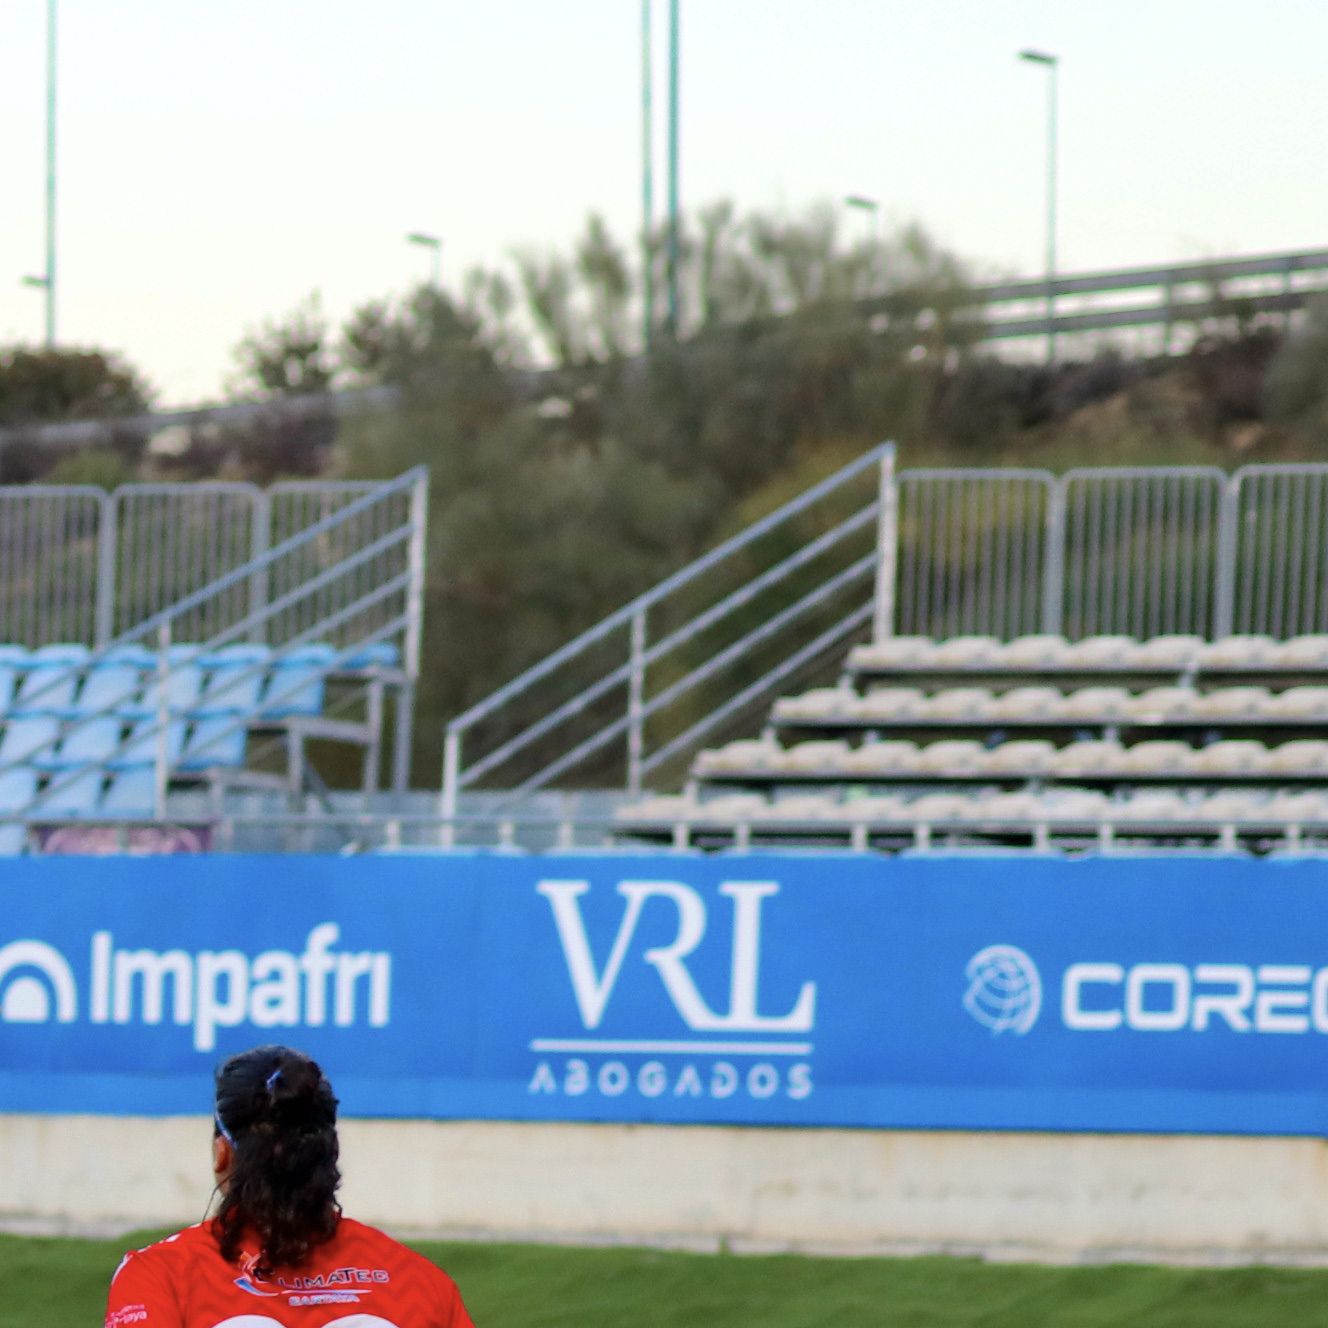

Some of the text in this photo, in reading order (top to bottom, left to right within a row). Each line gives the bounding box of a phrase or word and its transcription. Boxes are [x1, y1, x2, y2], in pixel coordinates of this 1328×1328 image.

[90, 921, 391, 1053] Impafri
[537, 879, 816, 1034] VRL
[1061, 963, 1328, 1034] CORE
[529, 1061, 814, 1099] ABOGADOS
